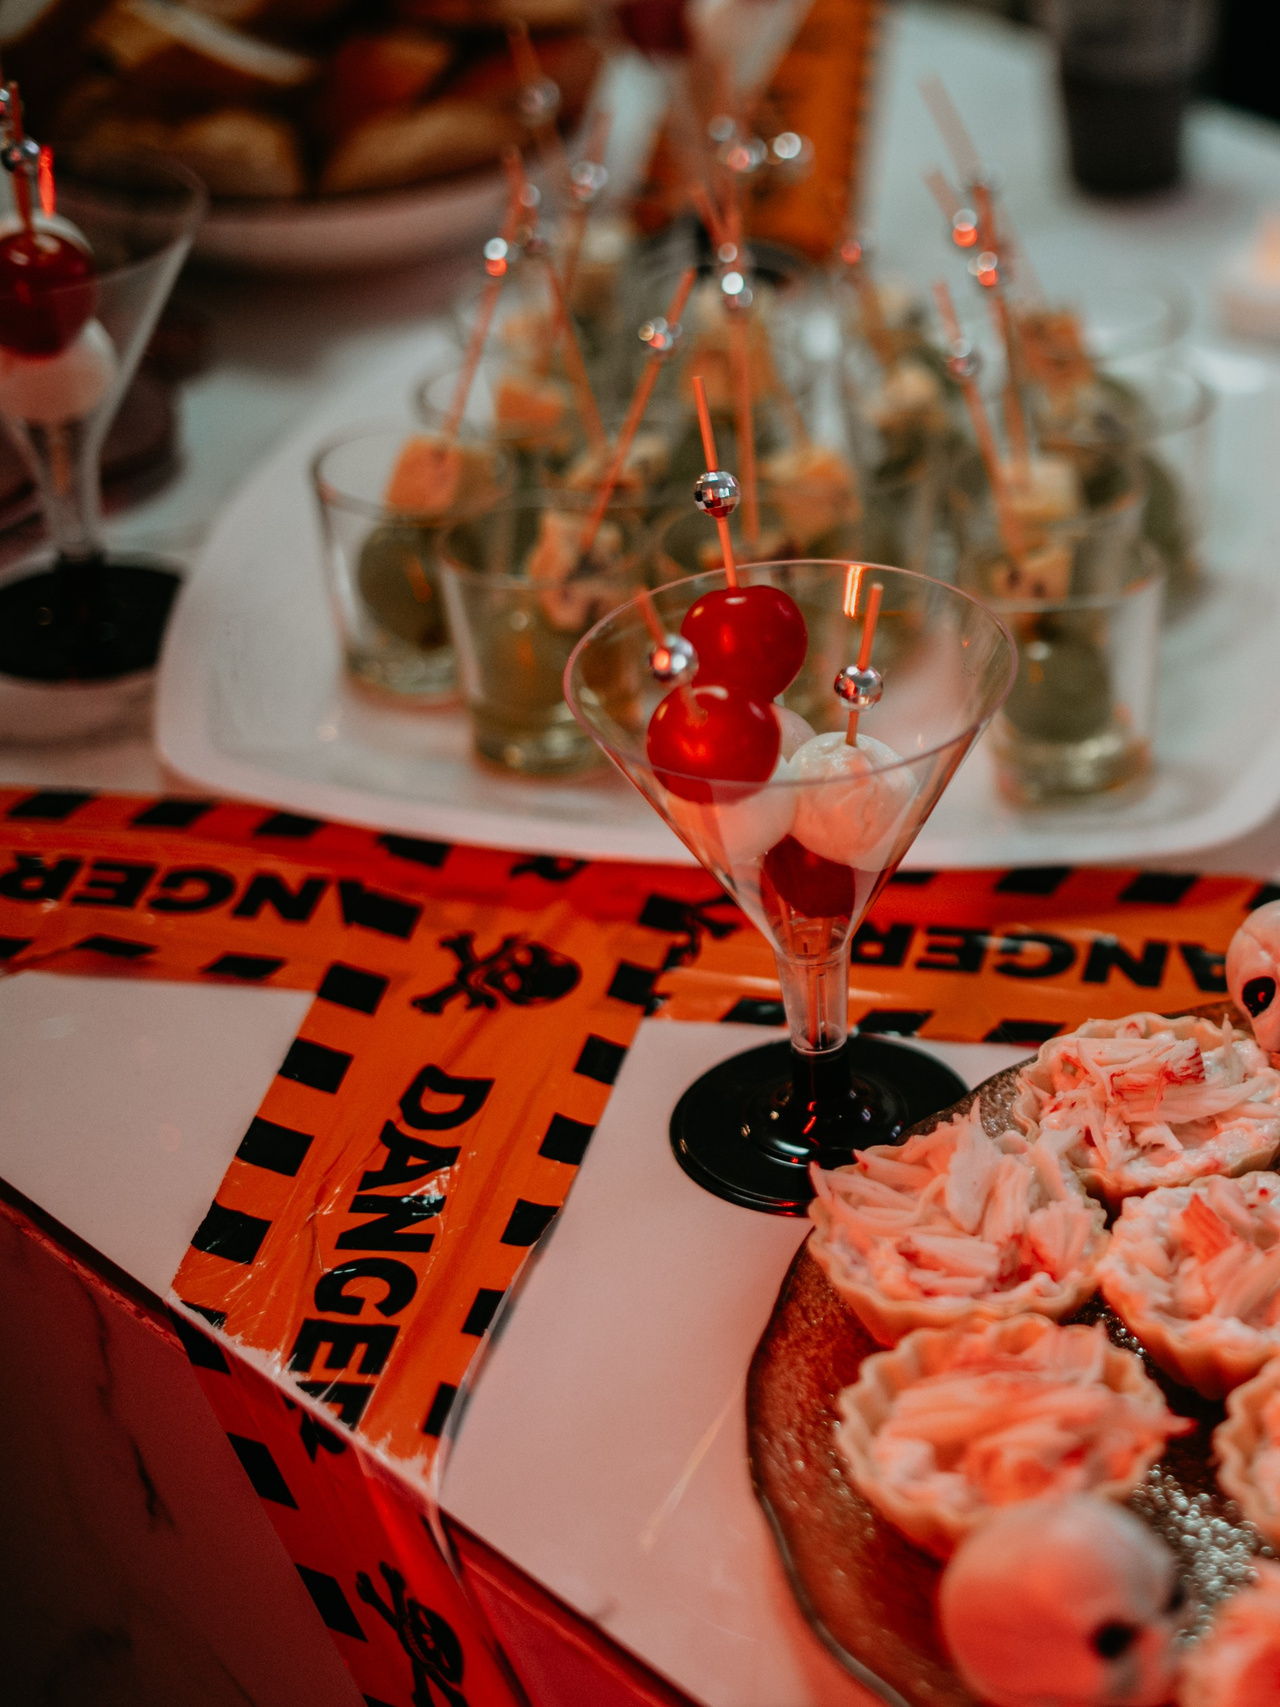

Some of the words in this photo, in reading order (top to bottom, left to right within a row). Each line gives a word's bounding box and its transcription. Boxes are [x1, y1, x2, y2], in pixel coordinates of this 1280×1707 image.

[0, 852, 362, 927] NGER
[851, 921, 1228, 994] ANGER
[281, 1063, 495, 1464] DANGER
